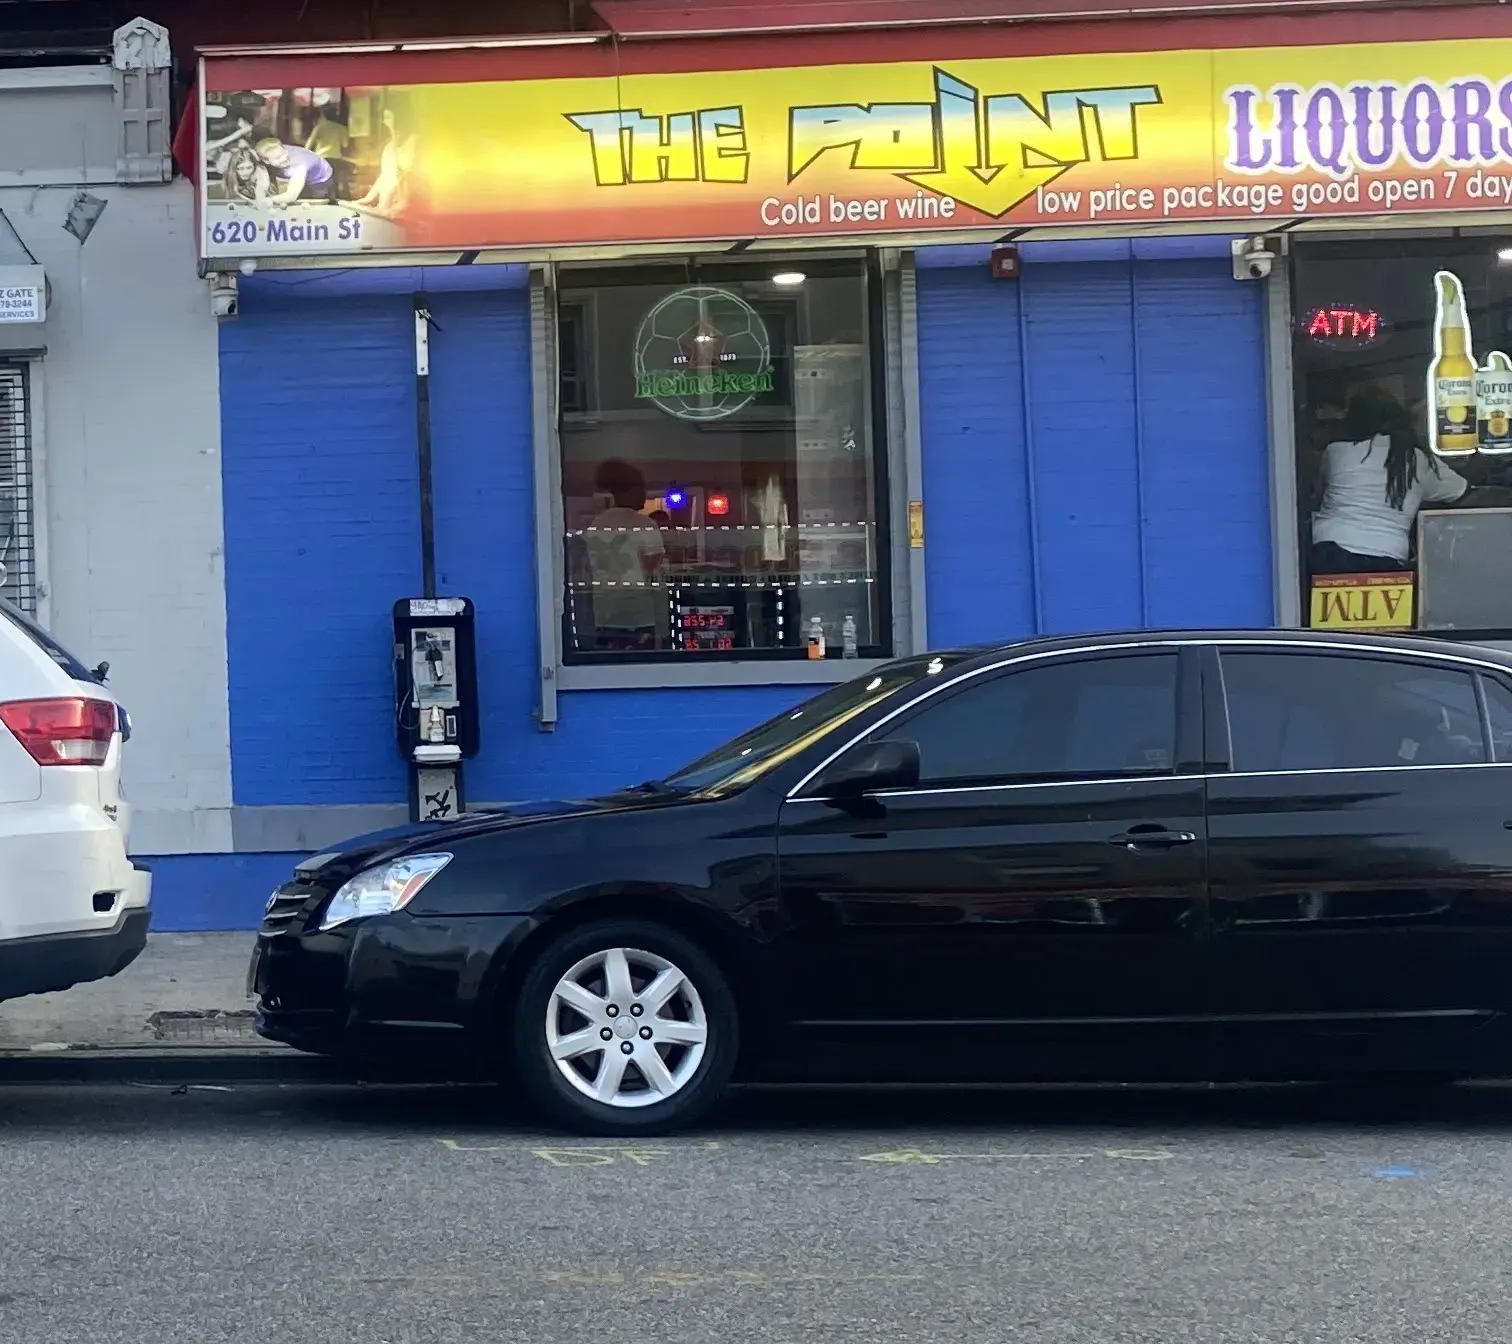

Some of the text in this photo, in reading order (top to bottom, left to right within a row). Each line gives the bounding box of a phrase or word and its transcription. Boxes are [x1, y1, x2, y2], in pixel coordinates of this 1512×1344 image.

[562, 66, 1163, 218] THE POINT
[760, 194, 821, 226] Cold
[829, 194, 889, 223] beer
[896, 190, 956, 219] wine
[1036, 185, 1081, 214] low
[1089, 180, 1155, 219] price
[1163, 178, 1283, 215] package
[1291, 174, 1360, 212] good
[1367, 177, 1435, 208] open
[1443, 171, 1458, 198] 7
[211, 217, 361, 244] 620 Main St
[6, 288, 34, 298] GATE
[1308, 309, 1378, 338] ATM
[635, 370, 774, 398] Heineken
[1318, 589, 1405, 622] ATM
